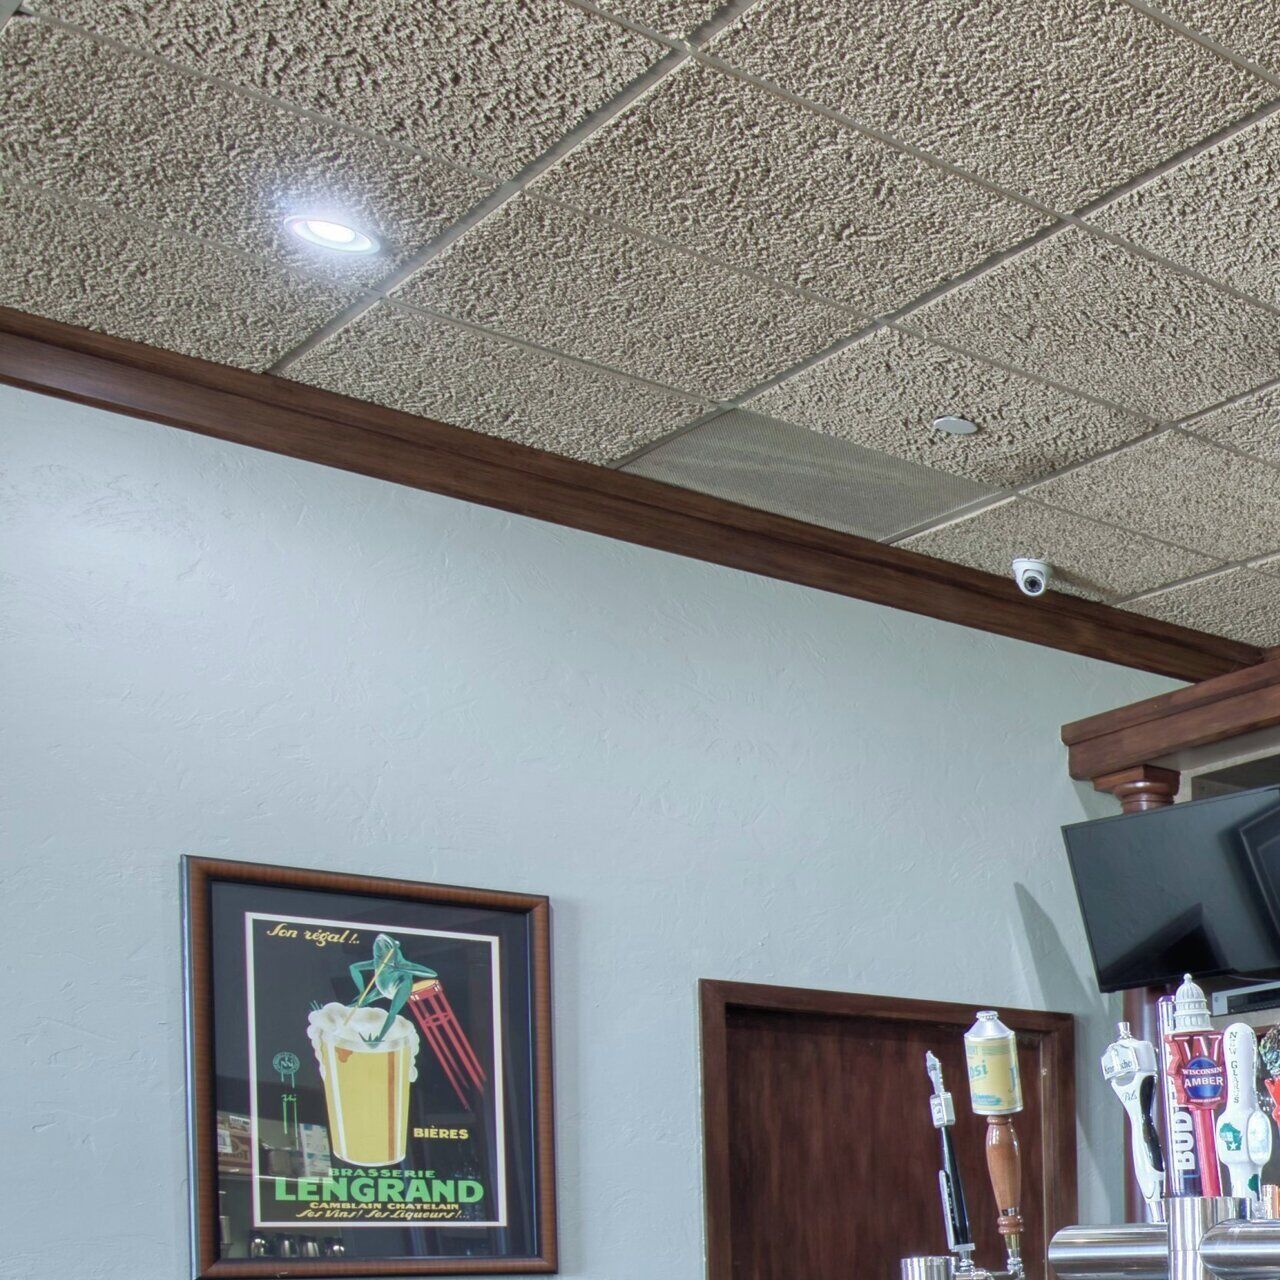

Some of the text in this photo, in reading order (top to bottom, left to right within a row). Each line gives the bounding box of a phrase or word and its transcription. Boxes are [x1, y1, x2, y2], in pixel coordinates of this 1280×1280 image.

[1181, 1065, 1223, 1076] WISCONSIN
[1184, 1076, 1225, 1088] AMBER
[414, 1125, 469, 1140] BIÈRES
[1175, 1110, 1195, 1171] BUD
[328, 1167, 436, 1179] BRASSERIE
[275, 1176, 485, 1203] LENGRAND
[309, 1201, 460, 1210] CAMBLAIN CHATELAIN
